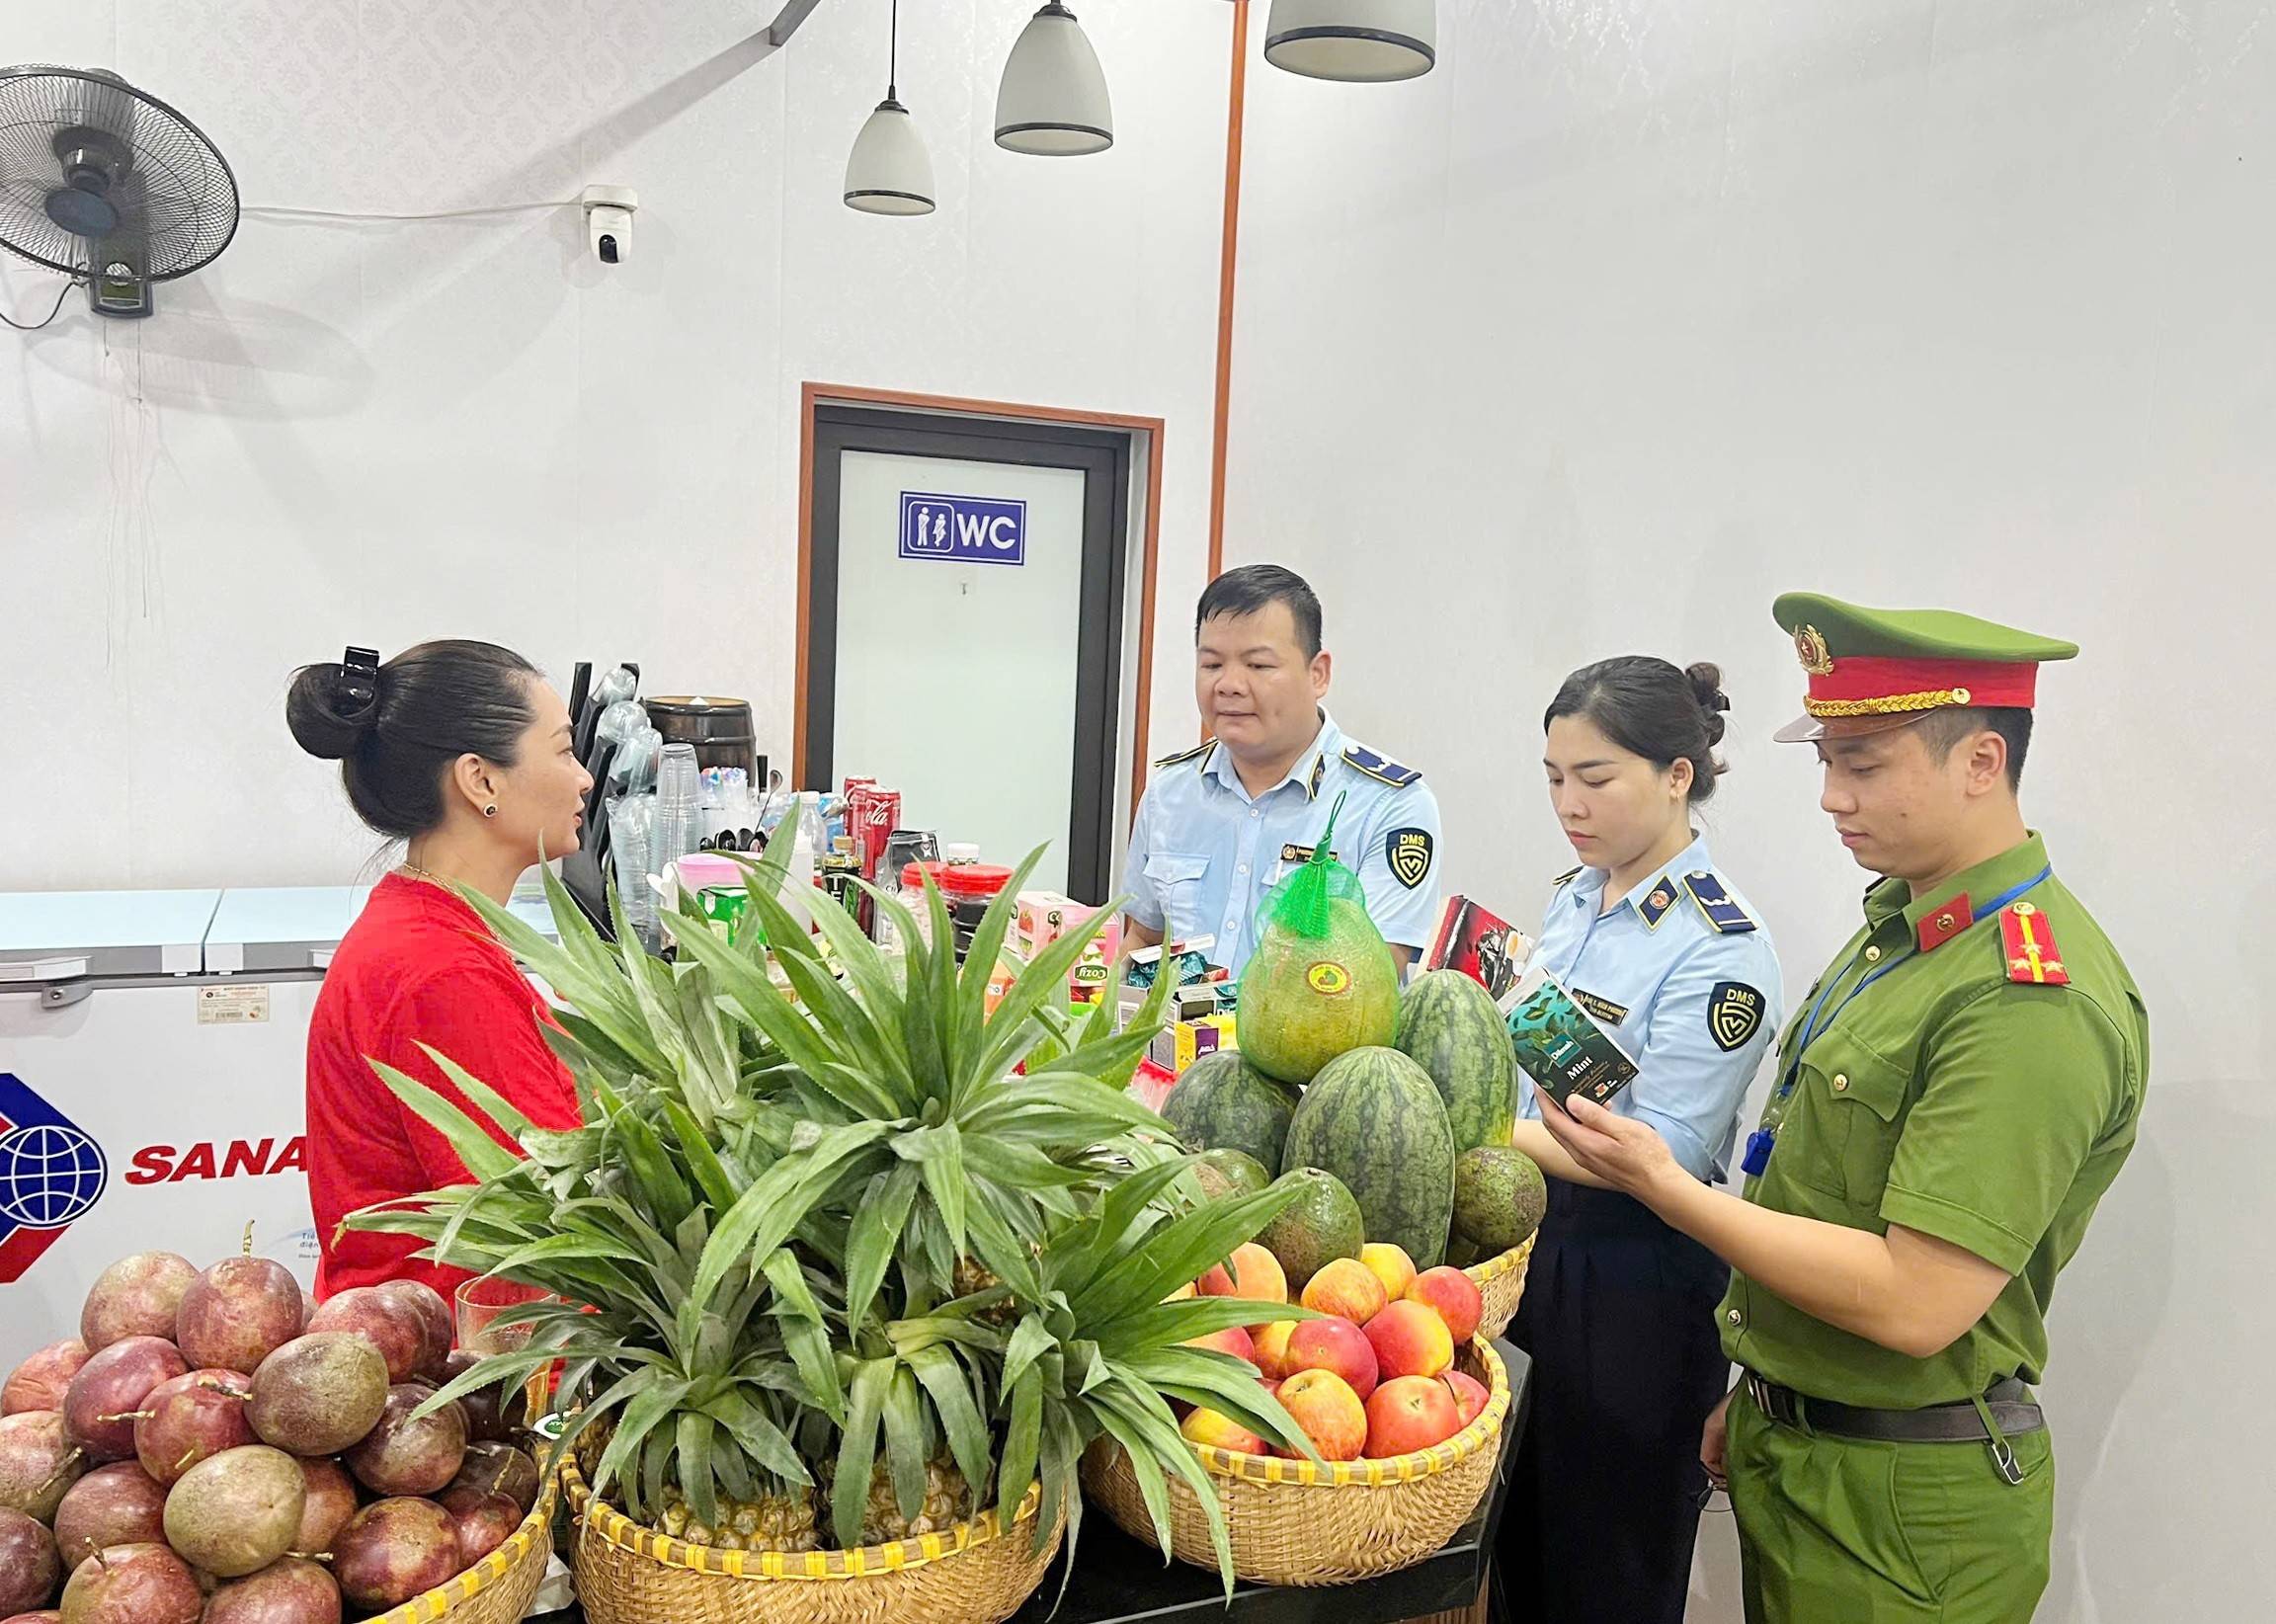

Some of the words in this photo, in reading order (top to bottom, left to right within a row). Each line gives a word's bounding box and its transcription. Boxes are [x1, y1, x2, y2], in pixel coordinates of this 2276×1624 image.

[956, 513, 1016, 549] WC
[1400, 834, 1424, 847] DMS
[1079, 966, 1106, 979] Cozy
[1726, 988, 1755, 1007] DMS
[1550, 1040, 1575, 1061] Dilmah
[1566, 1055, 1593, 1081] Mint
[124, 1136, 308, 1185] SANA
